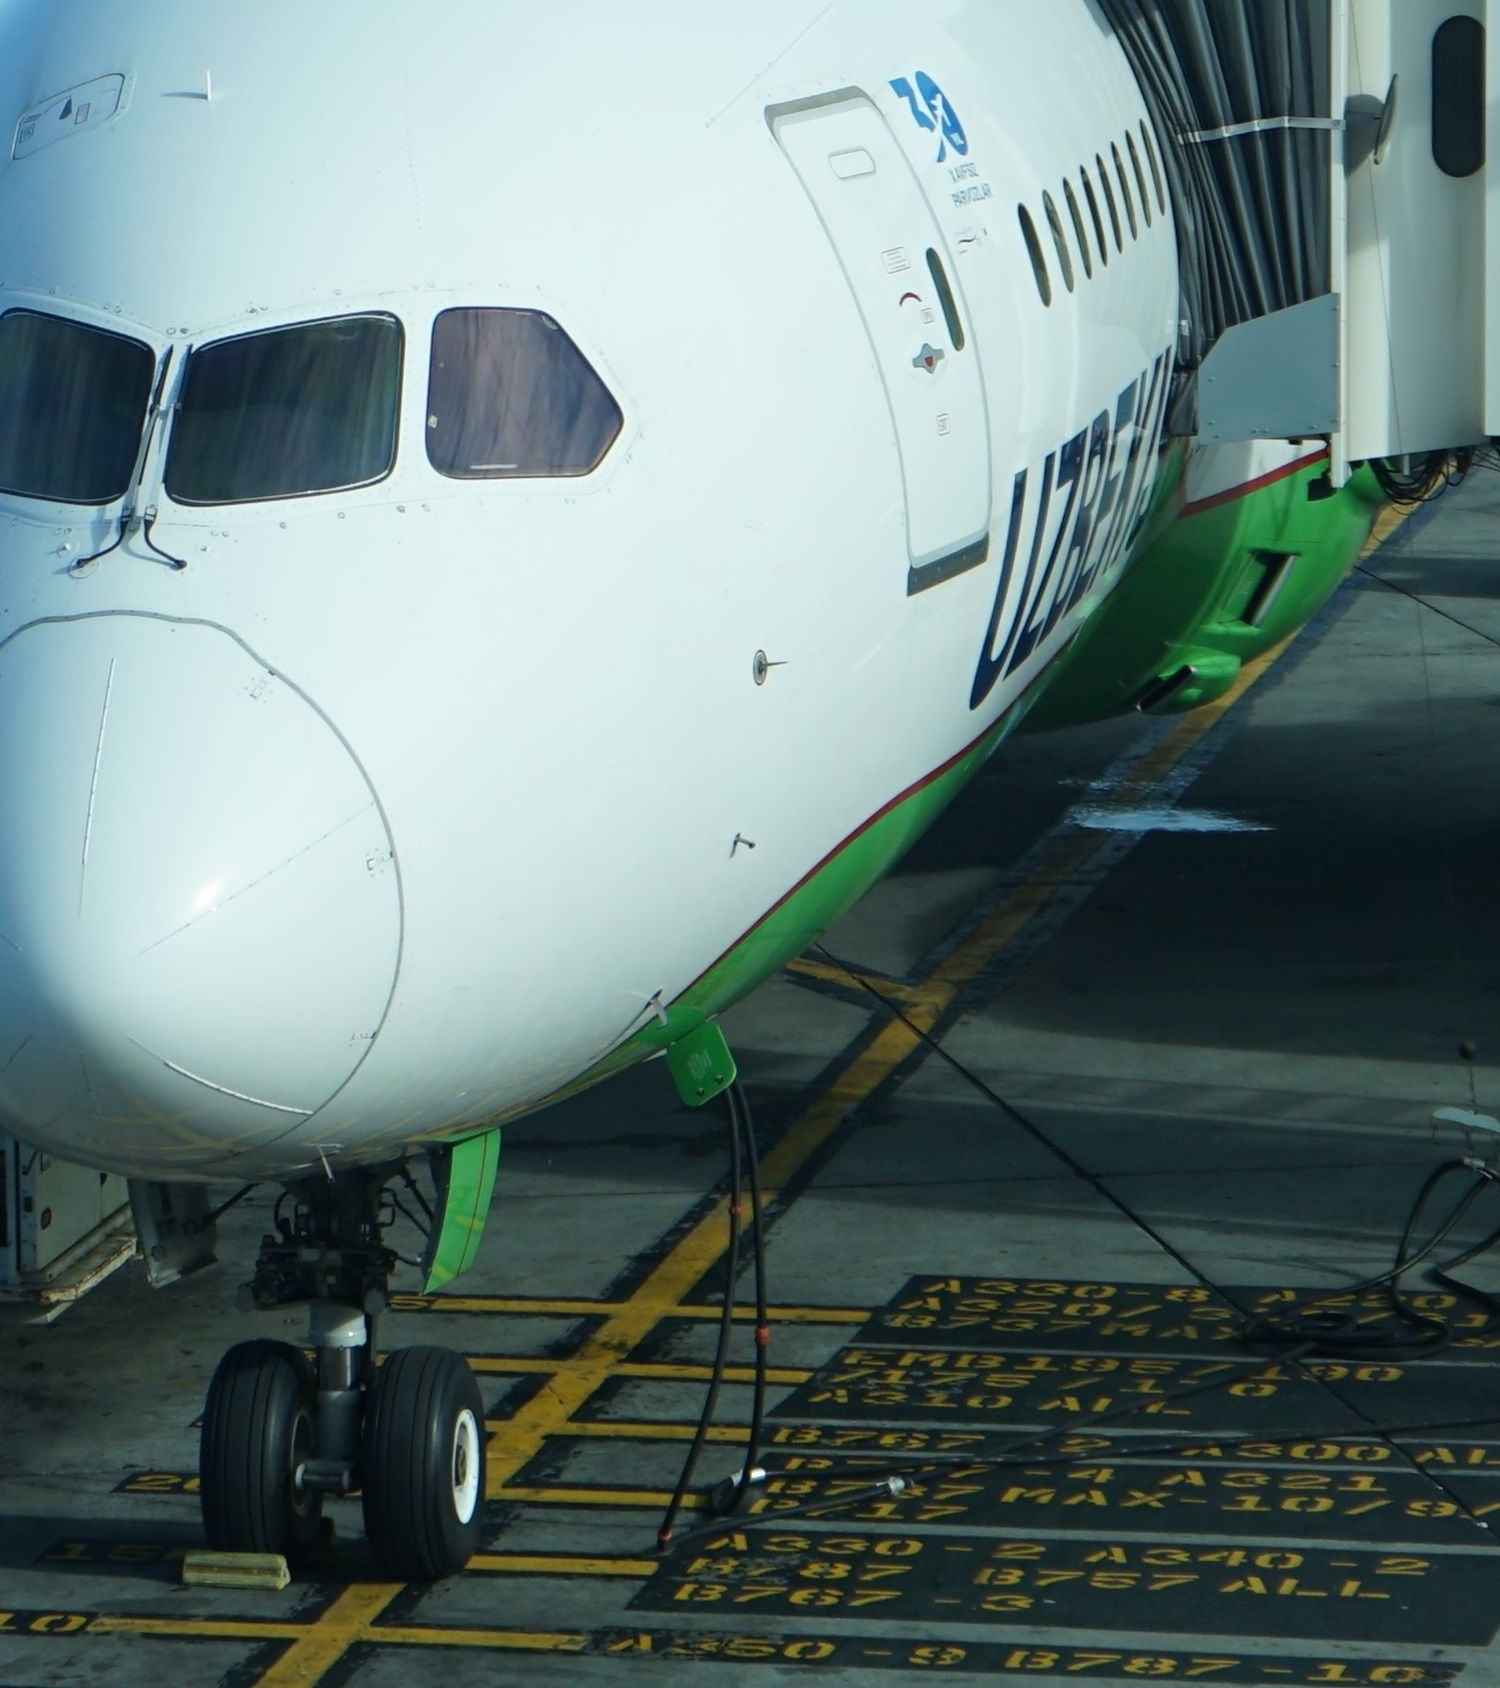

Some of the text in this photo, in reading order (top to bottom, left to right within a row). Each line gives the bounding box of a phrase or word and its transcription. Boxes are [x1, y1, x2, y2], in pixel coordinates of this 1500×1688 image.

[808, 1388, 1013, 1409] A310
[1160, 1468, 1387, 1492] A321
[973, 1566, 1200, 1591] B757
[1220, 1575, 1391, 1599] ALL
